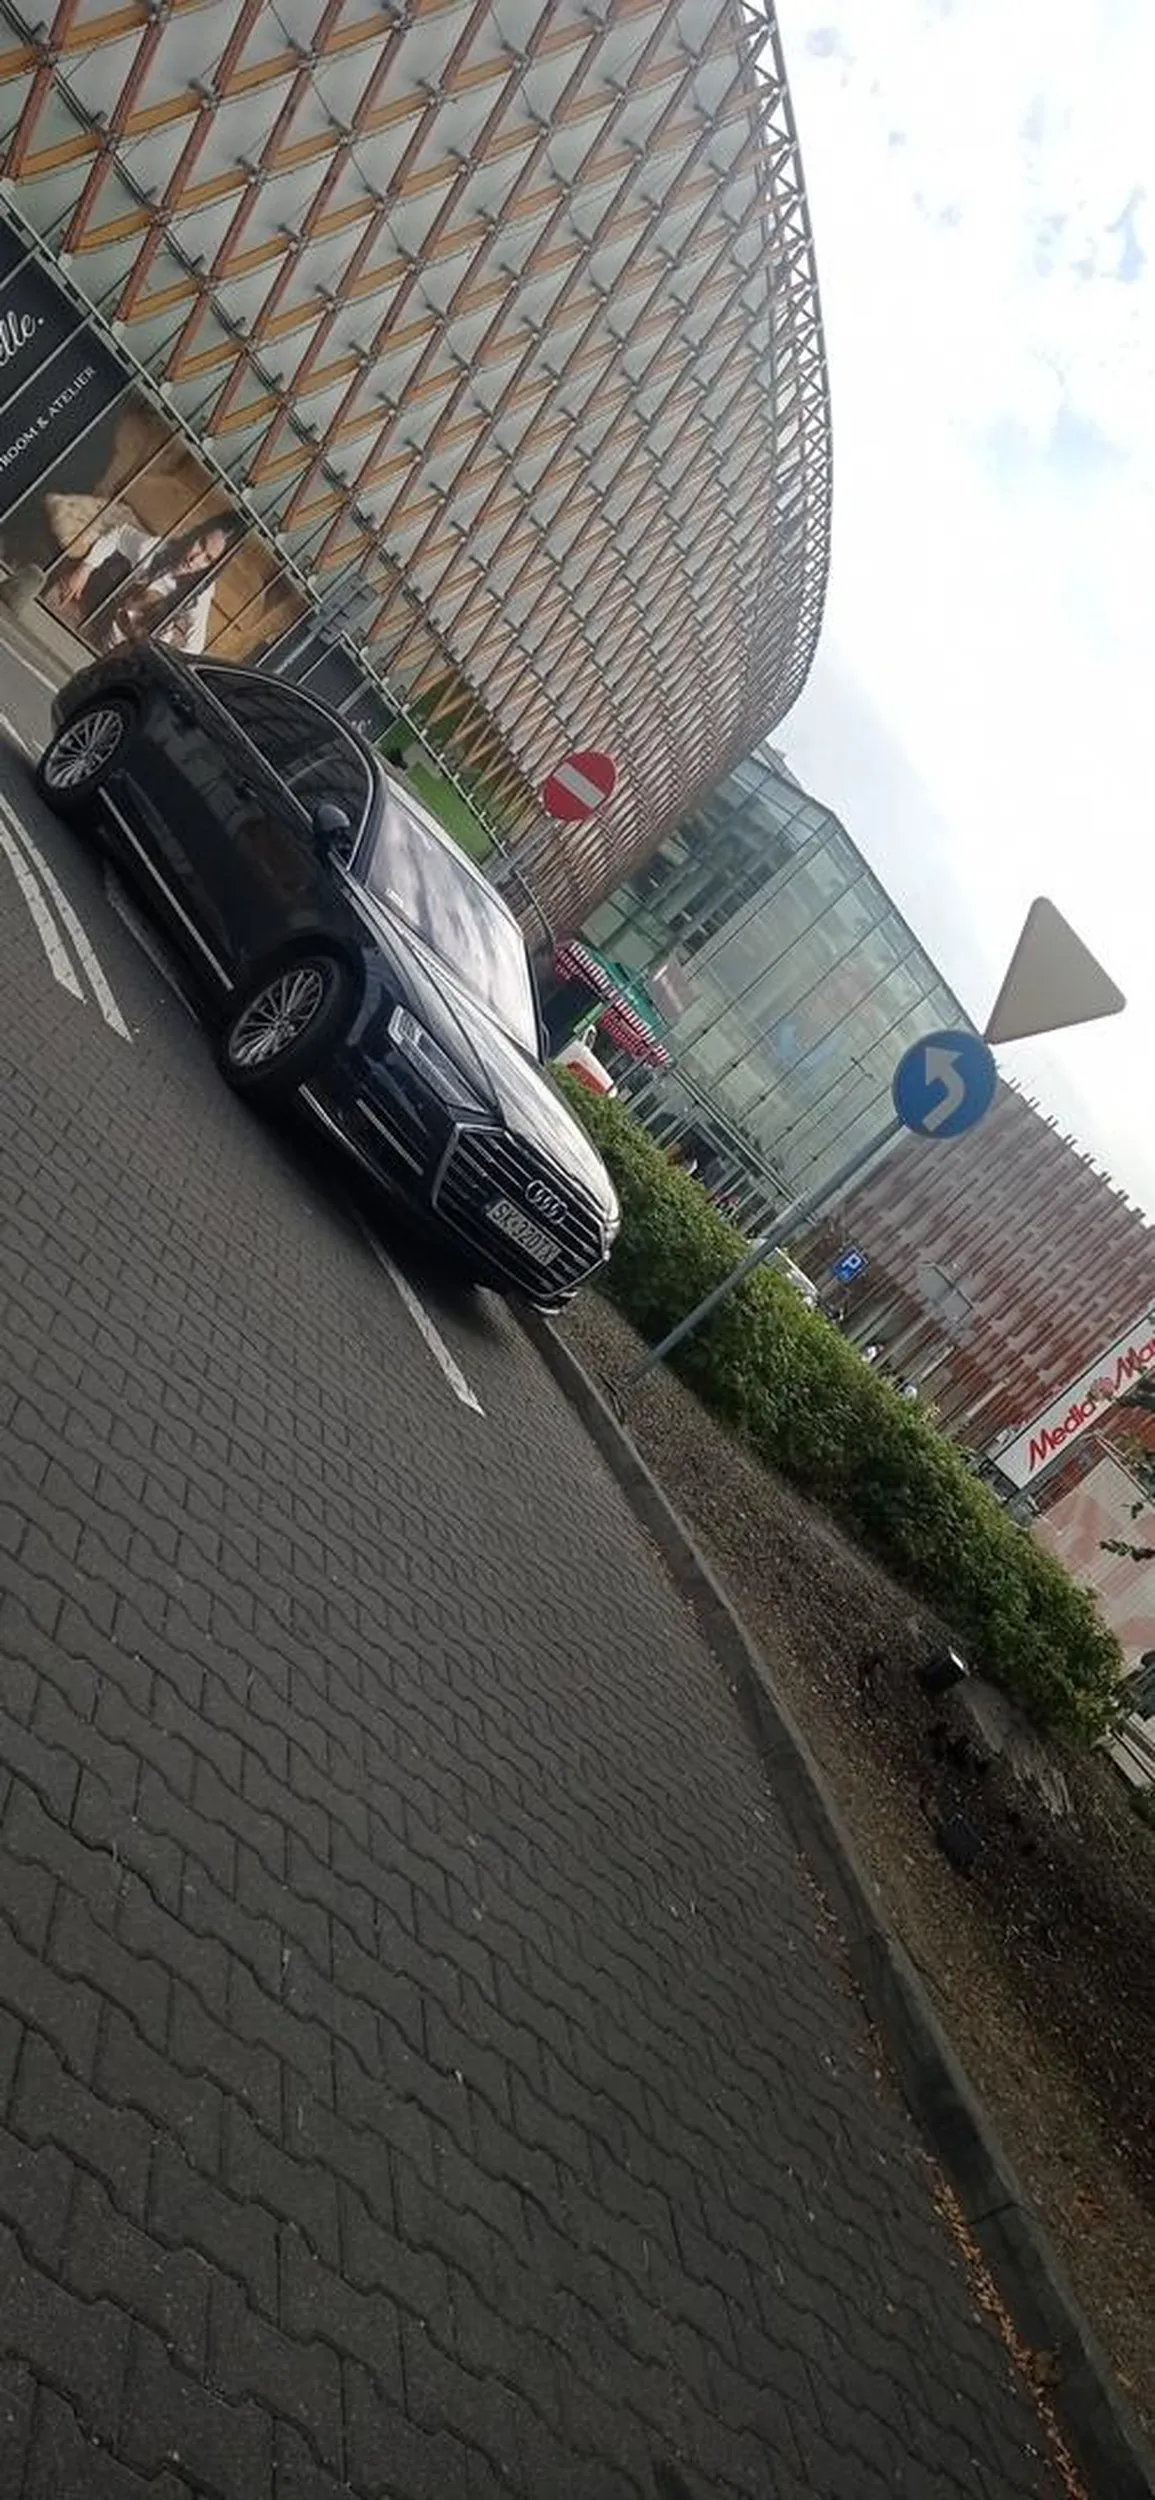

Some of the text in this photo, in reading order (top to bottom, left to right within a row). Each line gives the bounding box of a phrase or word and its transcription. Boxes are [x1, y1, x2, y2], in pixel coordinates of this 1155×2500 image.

[0, 366, 96, 472] ROOM & ATELIER
[842, 1253, 861, 1269] P
[1028, 1393, 1097, 1471] Media
